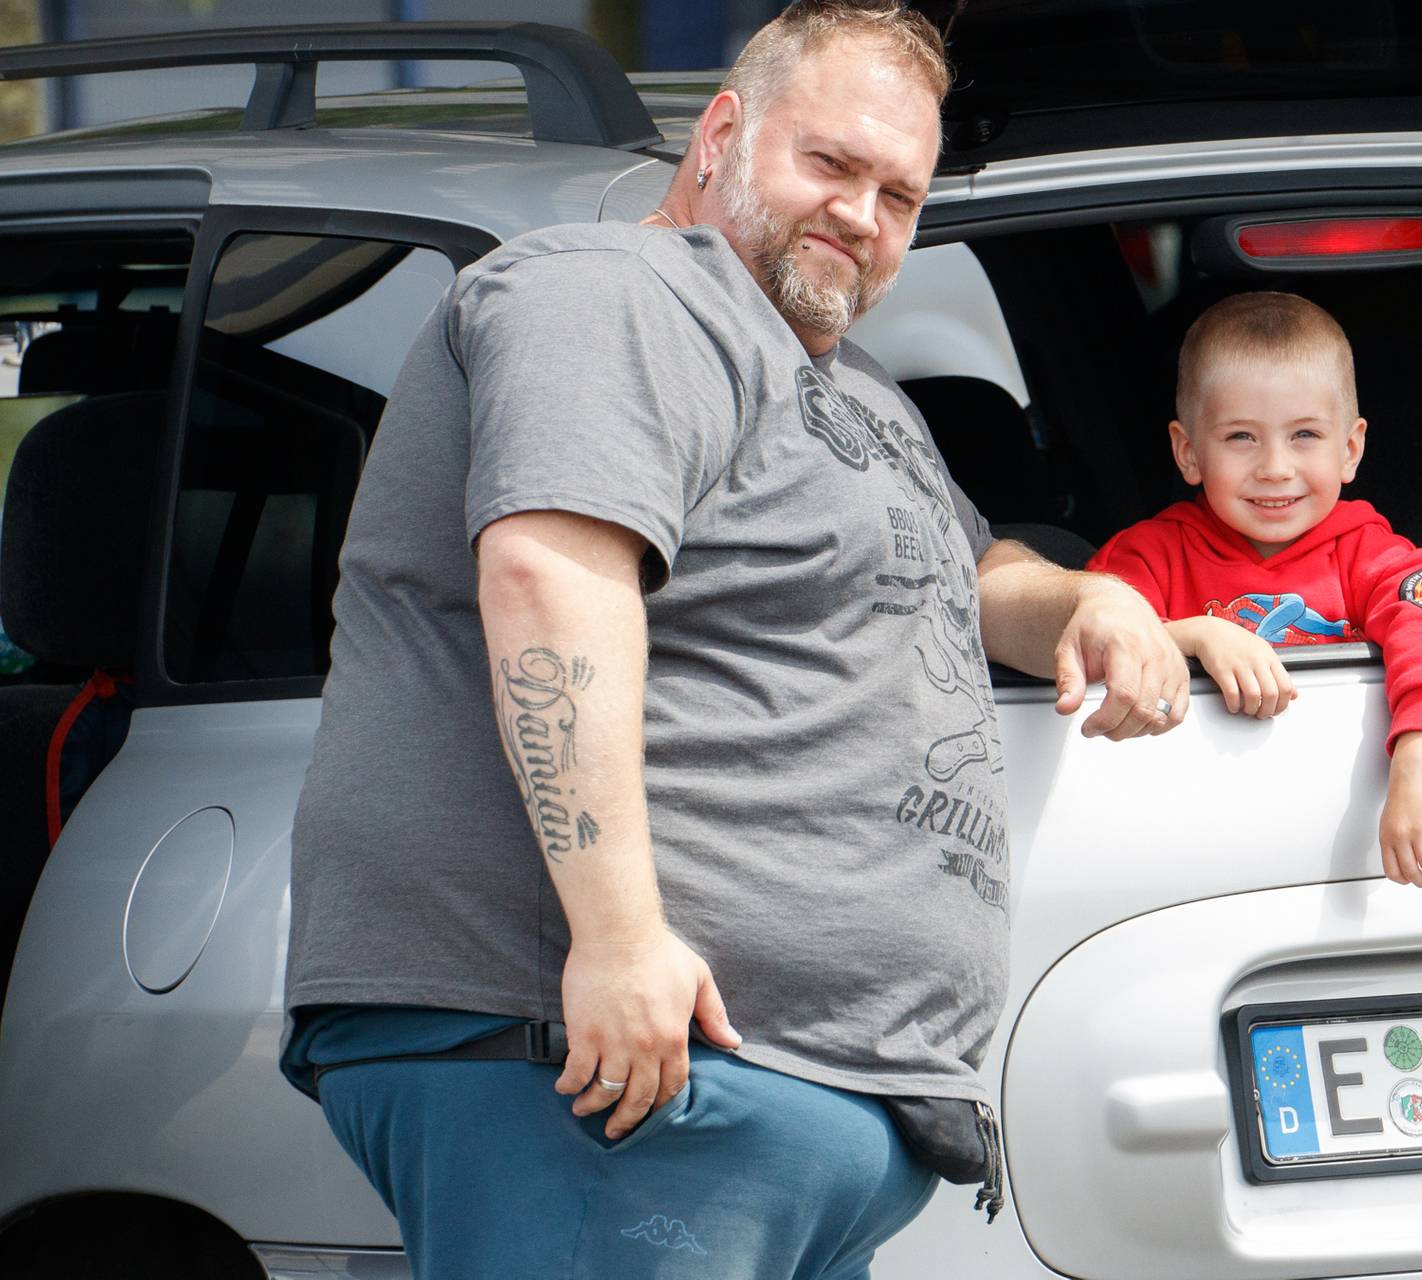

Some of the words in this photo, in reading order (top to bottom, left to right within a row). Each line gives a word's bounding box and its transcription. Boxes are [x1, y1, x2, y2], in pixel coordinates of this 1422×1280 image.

[894, 533, 925, 562] BEER
[1317, 1036, 1385, 1137] E
[1279, 1105, 1300, 1135] D
